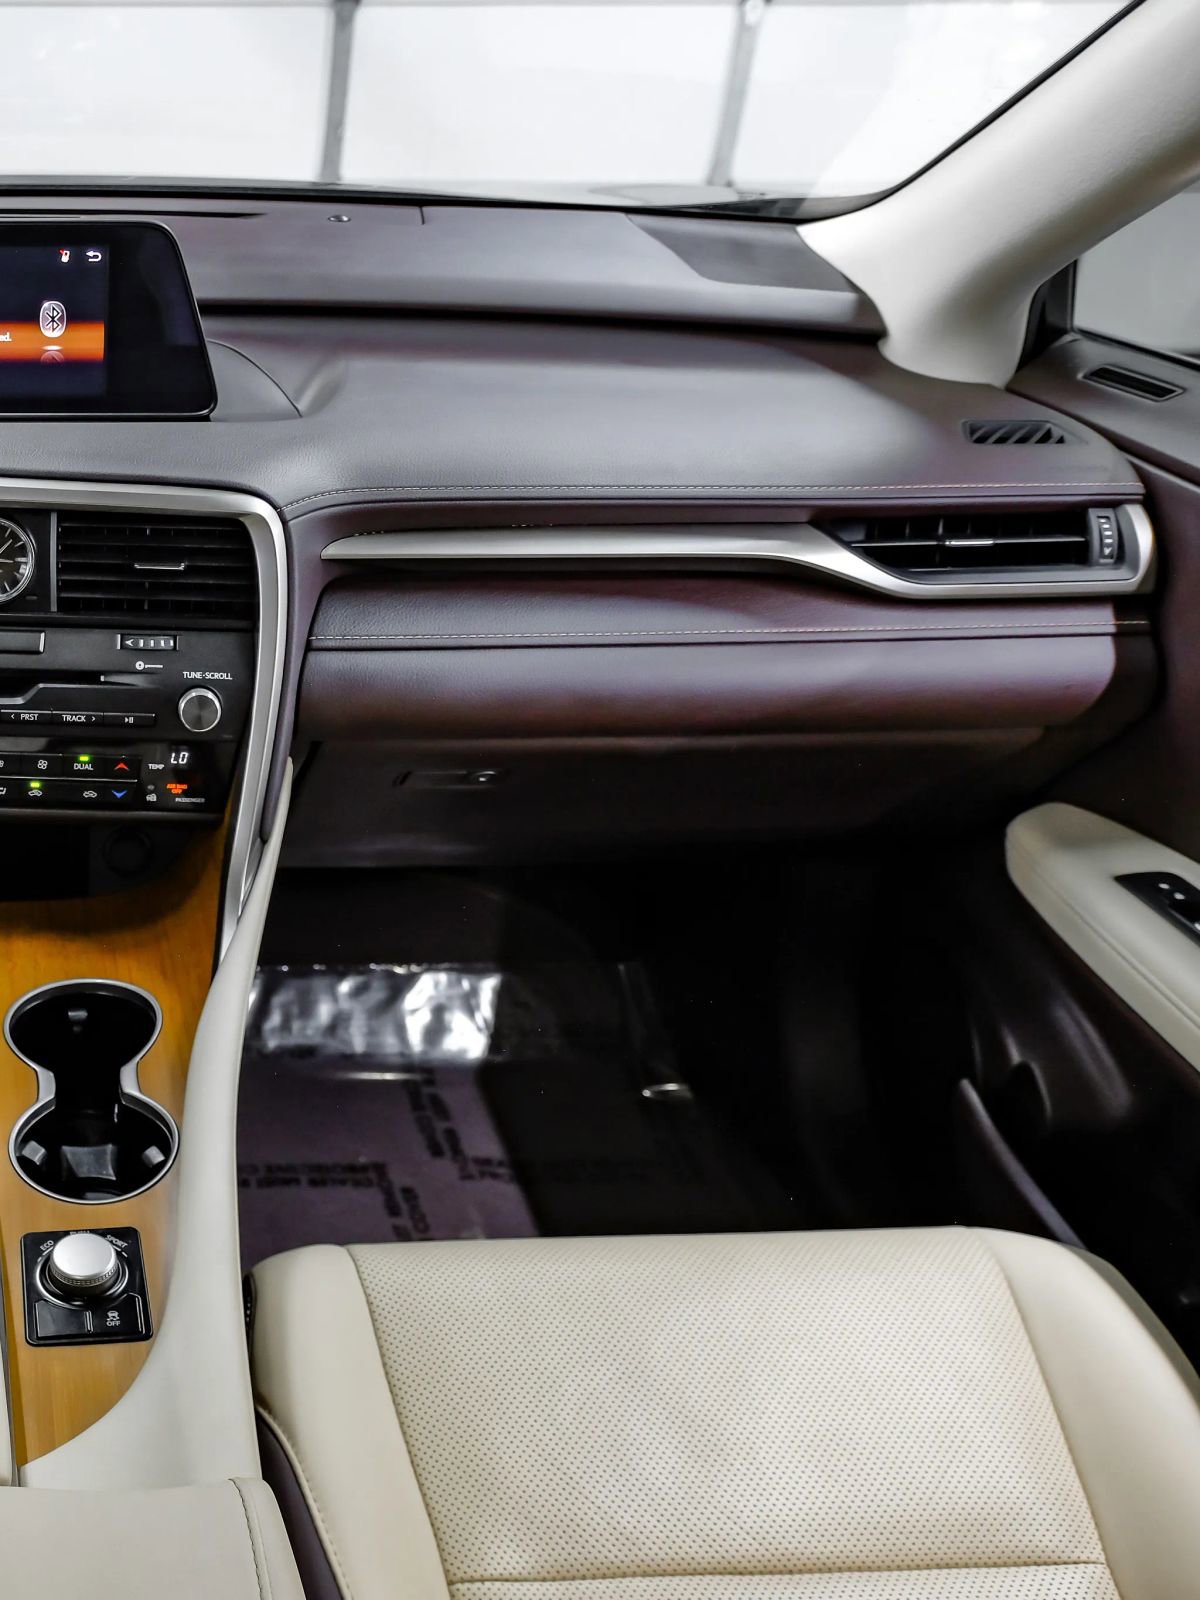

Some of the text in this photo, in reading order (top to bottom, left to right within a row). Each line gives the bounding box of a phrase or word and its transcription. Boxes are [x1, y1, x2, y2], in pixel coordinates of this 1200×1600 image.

[20, 713, 39, 722] PRST
[61, 714, 87, 723] TRACK
[73, 763, 94, 771] DUAL
[40, 1240, 55, 1252] ECO
[105, 1234, 128, 1249] SPORT
[106, 1320, 121, 1328] OFF
